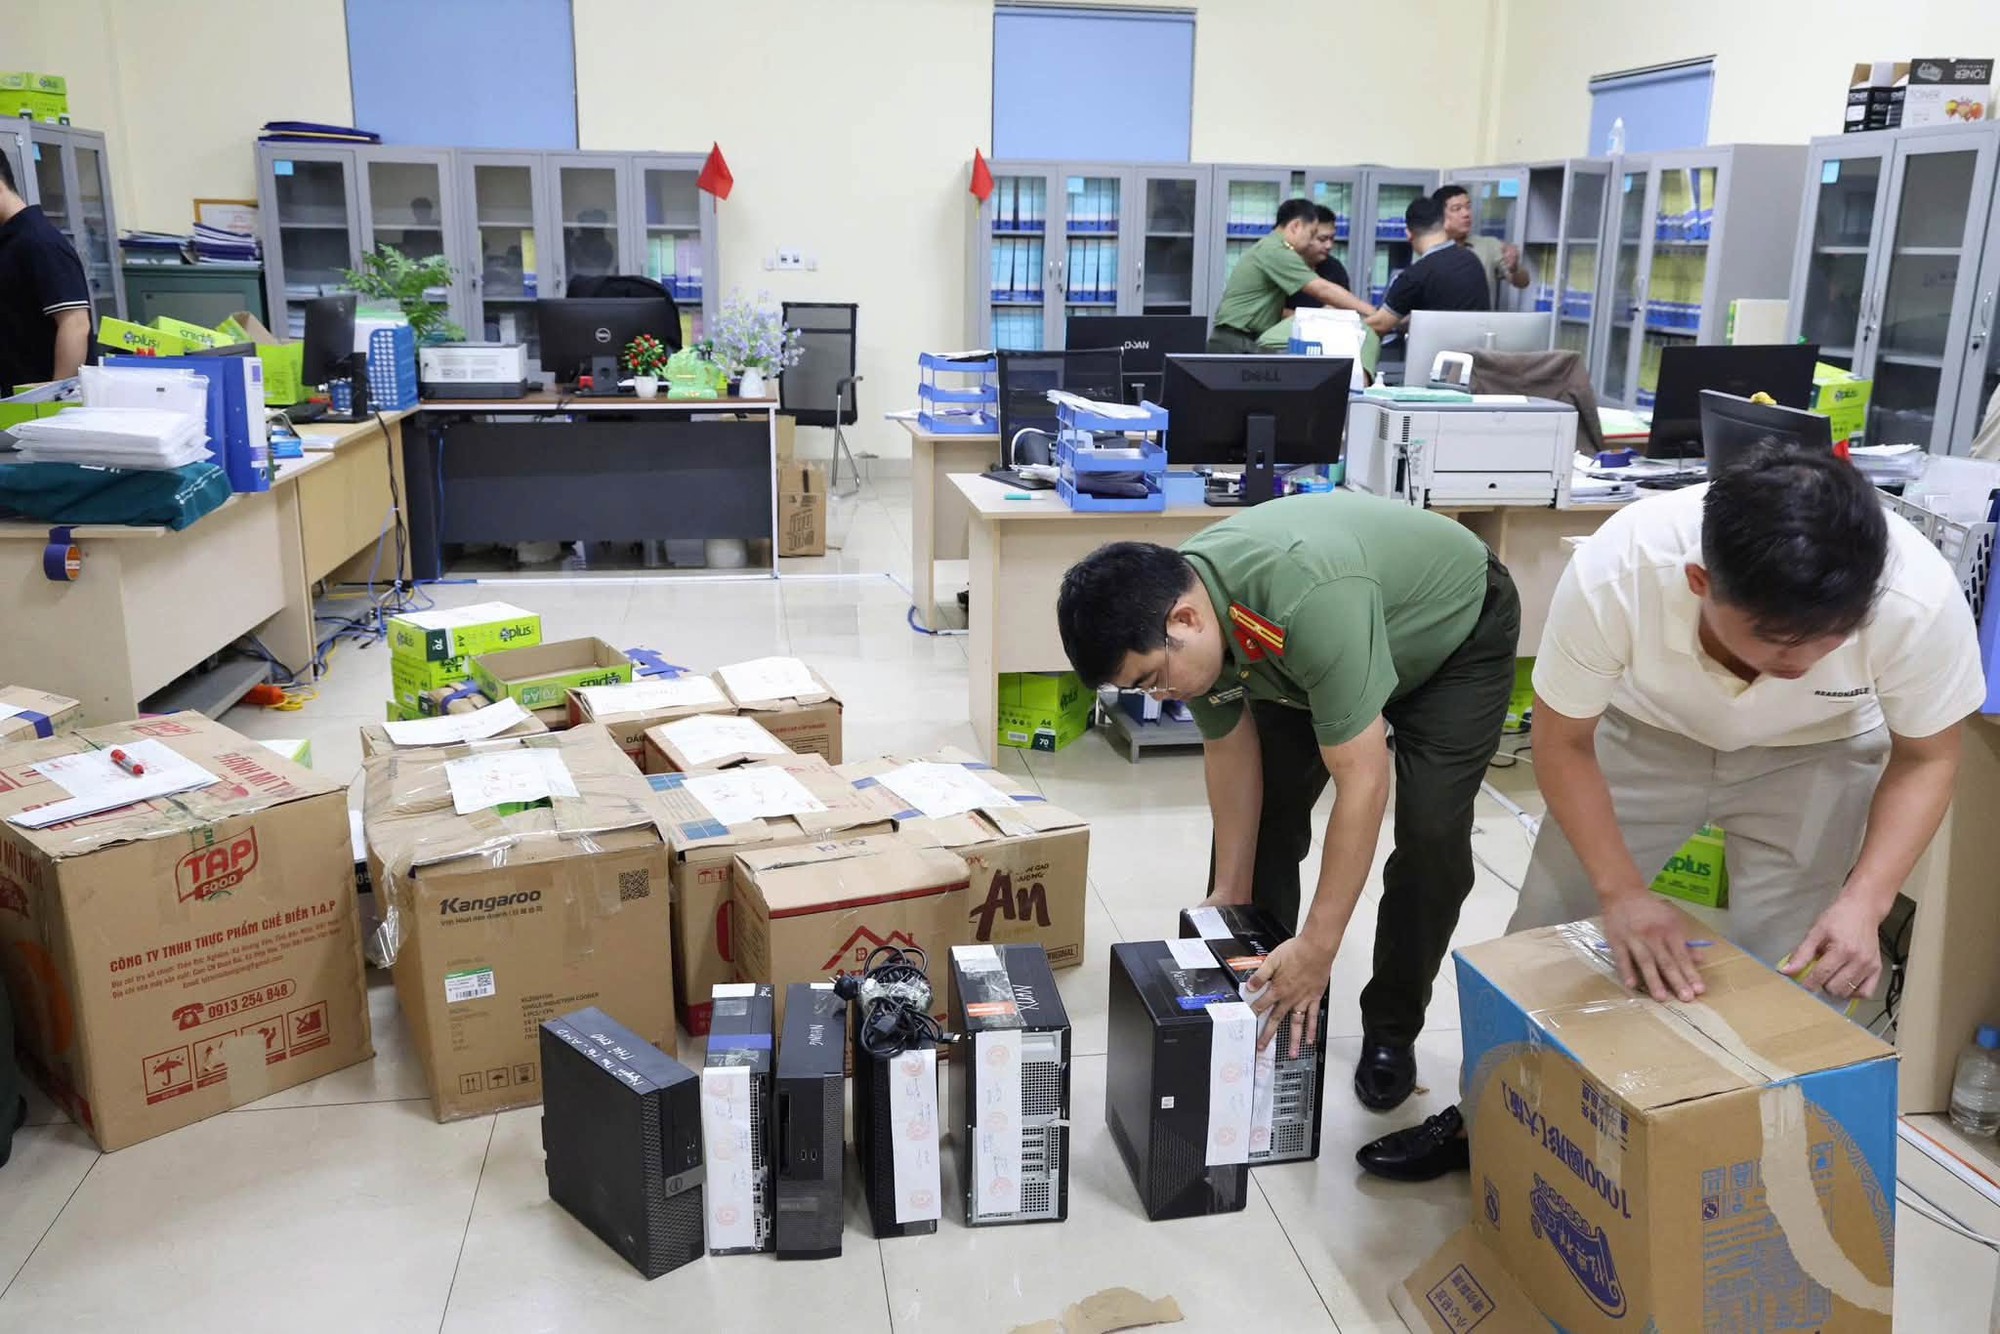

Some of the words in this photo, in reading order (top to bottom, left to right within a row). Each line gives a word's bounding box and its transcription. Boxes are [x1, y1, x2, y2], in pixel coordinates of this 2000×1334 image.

[1242, 369, 1281, 382] DELL
[508, 624, 532, 642] plus
[183, 839, 253, 884] TAP
[202, 874, 238, 896] FOOD
[439, 889, 542, 915] Kangaroo
[969, 868, 1052, 942] An
[109, 953, 143, 973] CÔNG
[145, 949, 160, 963] TY
[161, 941, 193, 959] TNHH
[284, 905, 309, 924] BIẾN
[310, 900, 337, 918] T.A.P
[209, 999, 239, 1019] 0913
[240, 991, 264, 1009] 254
[266, 983, 289, 1001] 848
